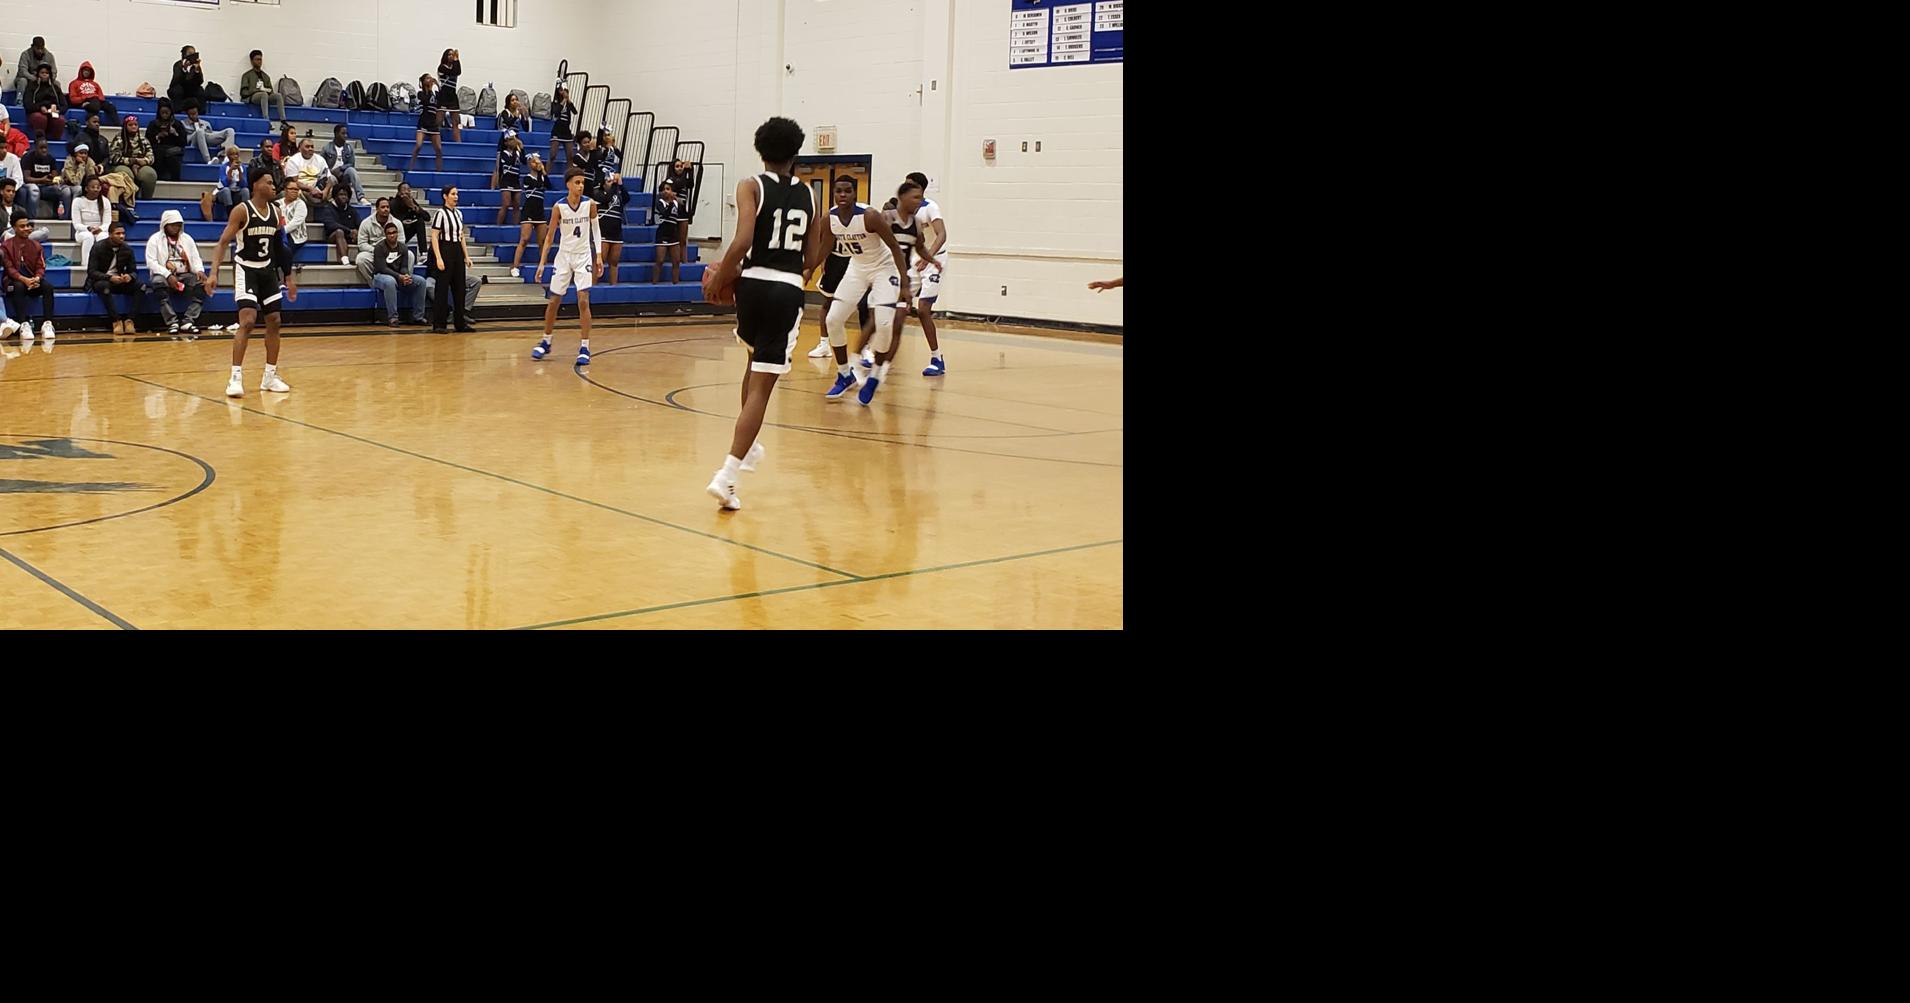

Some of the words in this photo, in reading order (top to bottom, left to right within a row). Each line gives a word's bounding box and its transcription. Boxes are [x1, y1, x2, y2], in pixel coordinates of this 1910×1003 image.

[819, 135, 830, 146] EXIT
[573, 225, 581, 238] 4
[768, 208, 808, 251] 12
[257, 237, 270, 258] 3
